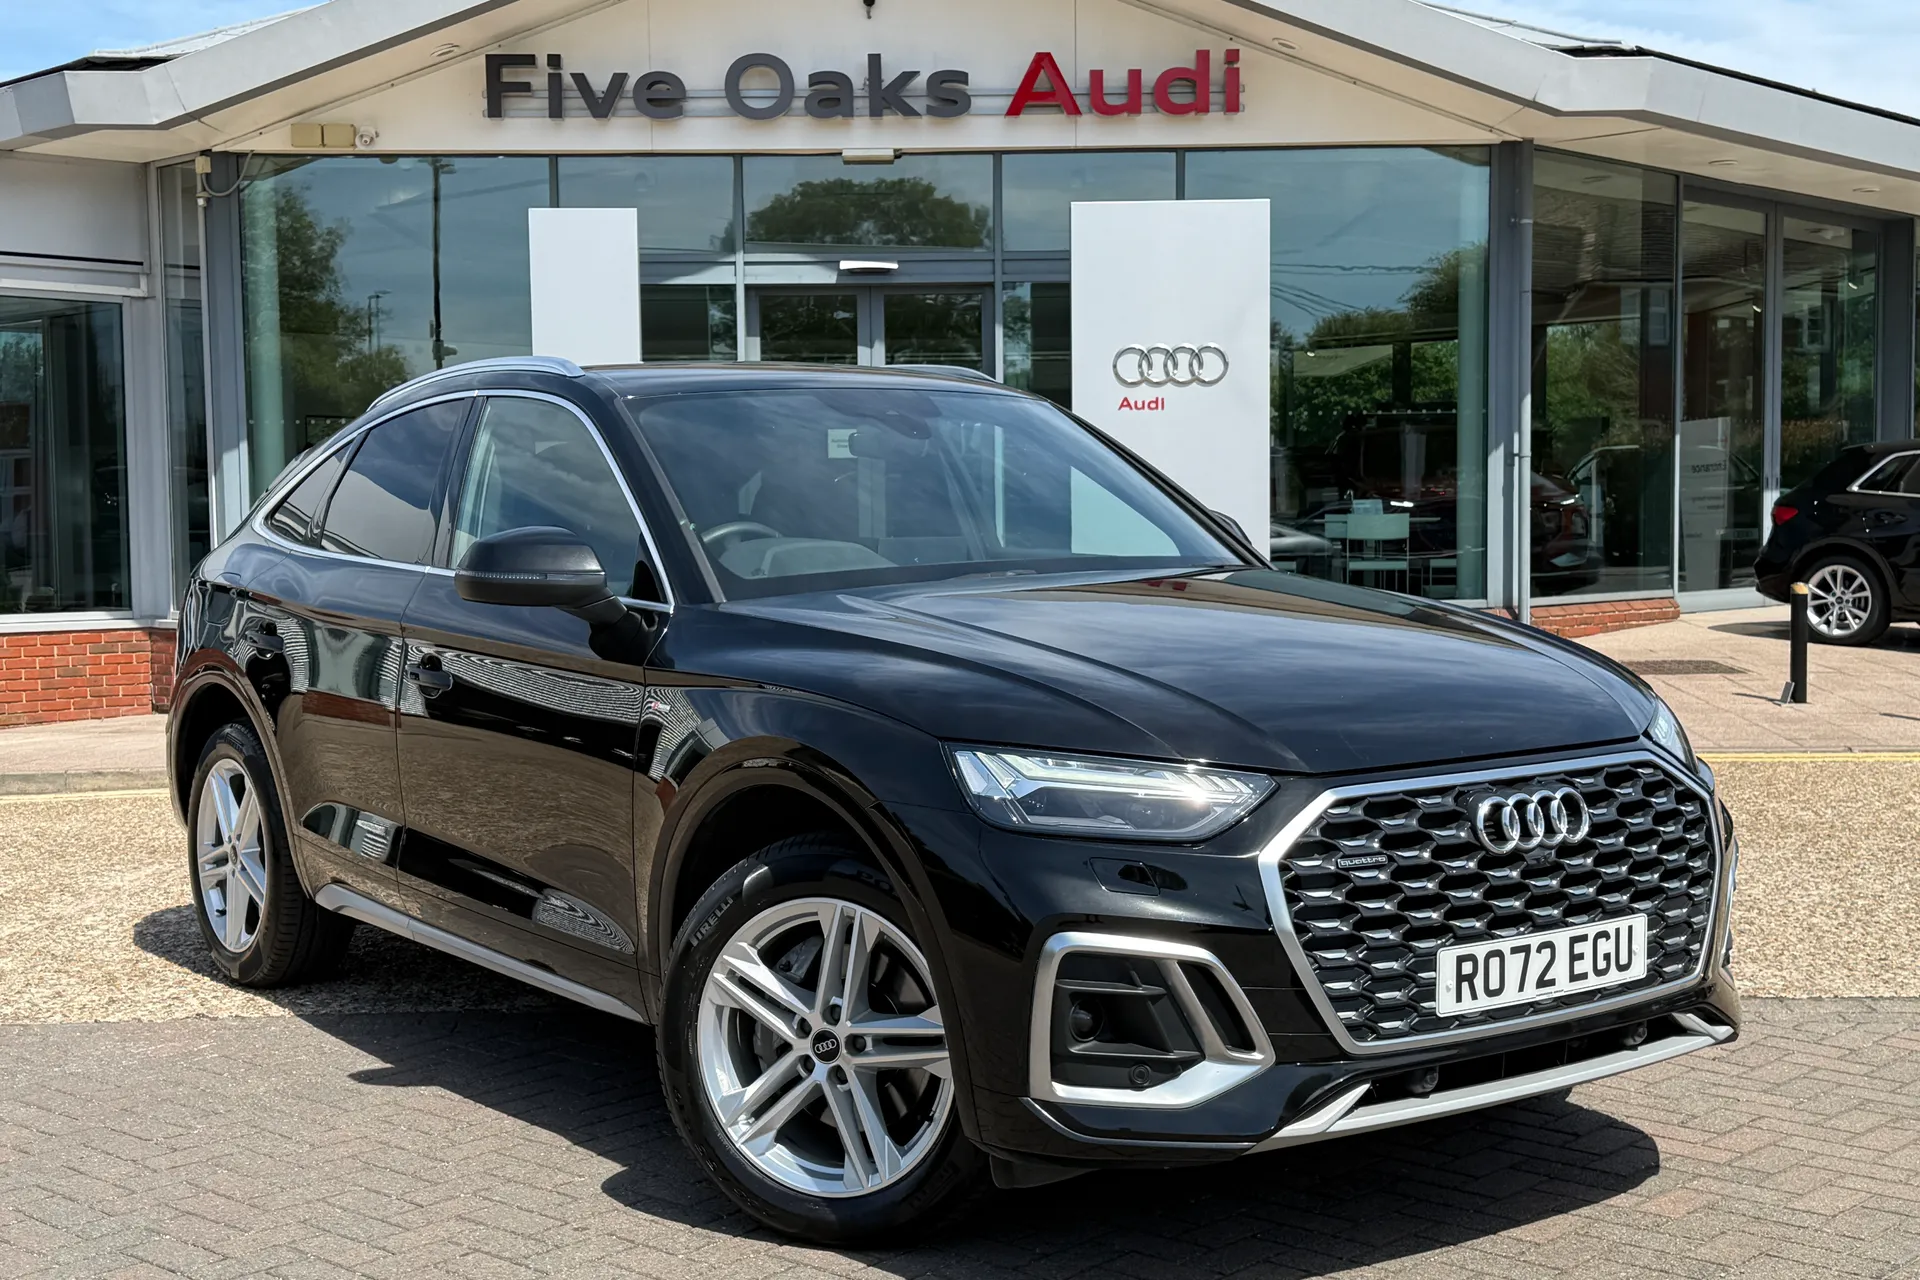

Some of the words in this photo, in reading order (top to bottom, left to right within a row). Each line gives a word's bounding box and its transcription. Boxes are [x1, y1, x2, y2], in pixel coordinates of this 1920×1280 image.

[485, 53, 686, 120] Five
[724, 52, 972, 121] Oaks
[1004, 48, 1241, 119] Audi
[1117, 396, 1165, 411] Audi
[1340, 856, 1386, 867] quattro
[1455, 940, 1557, 1004] RO72
[1568, 924, 1634, 984] EGU
